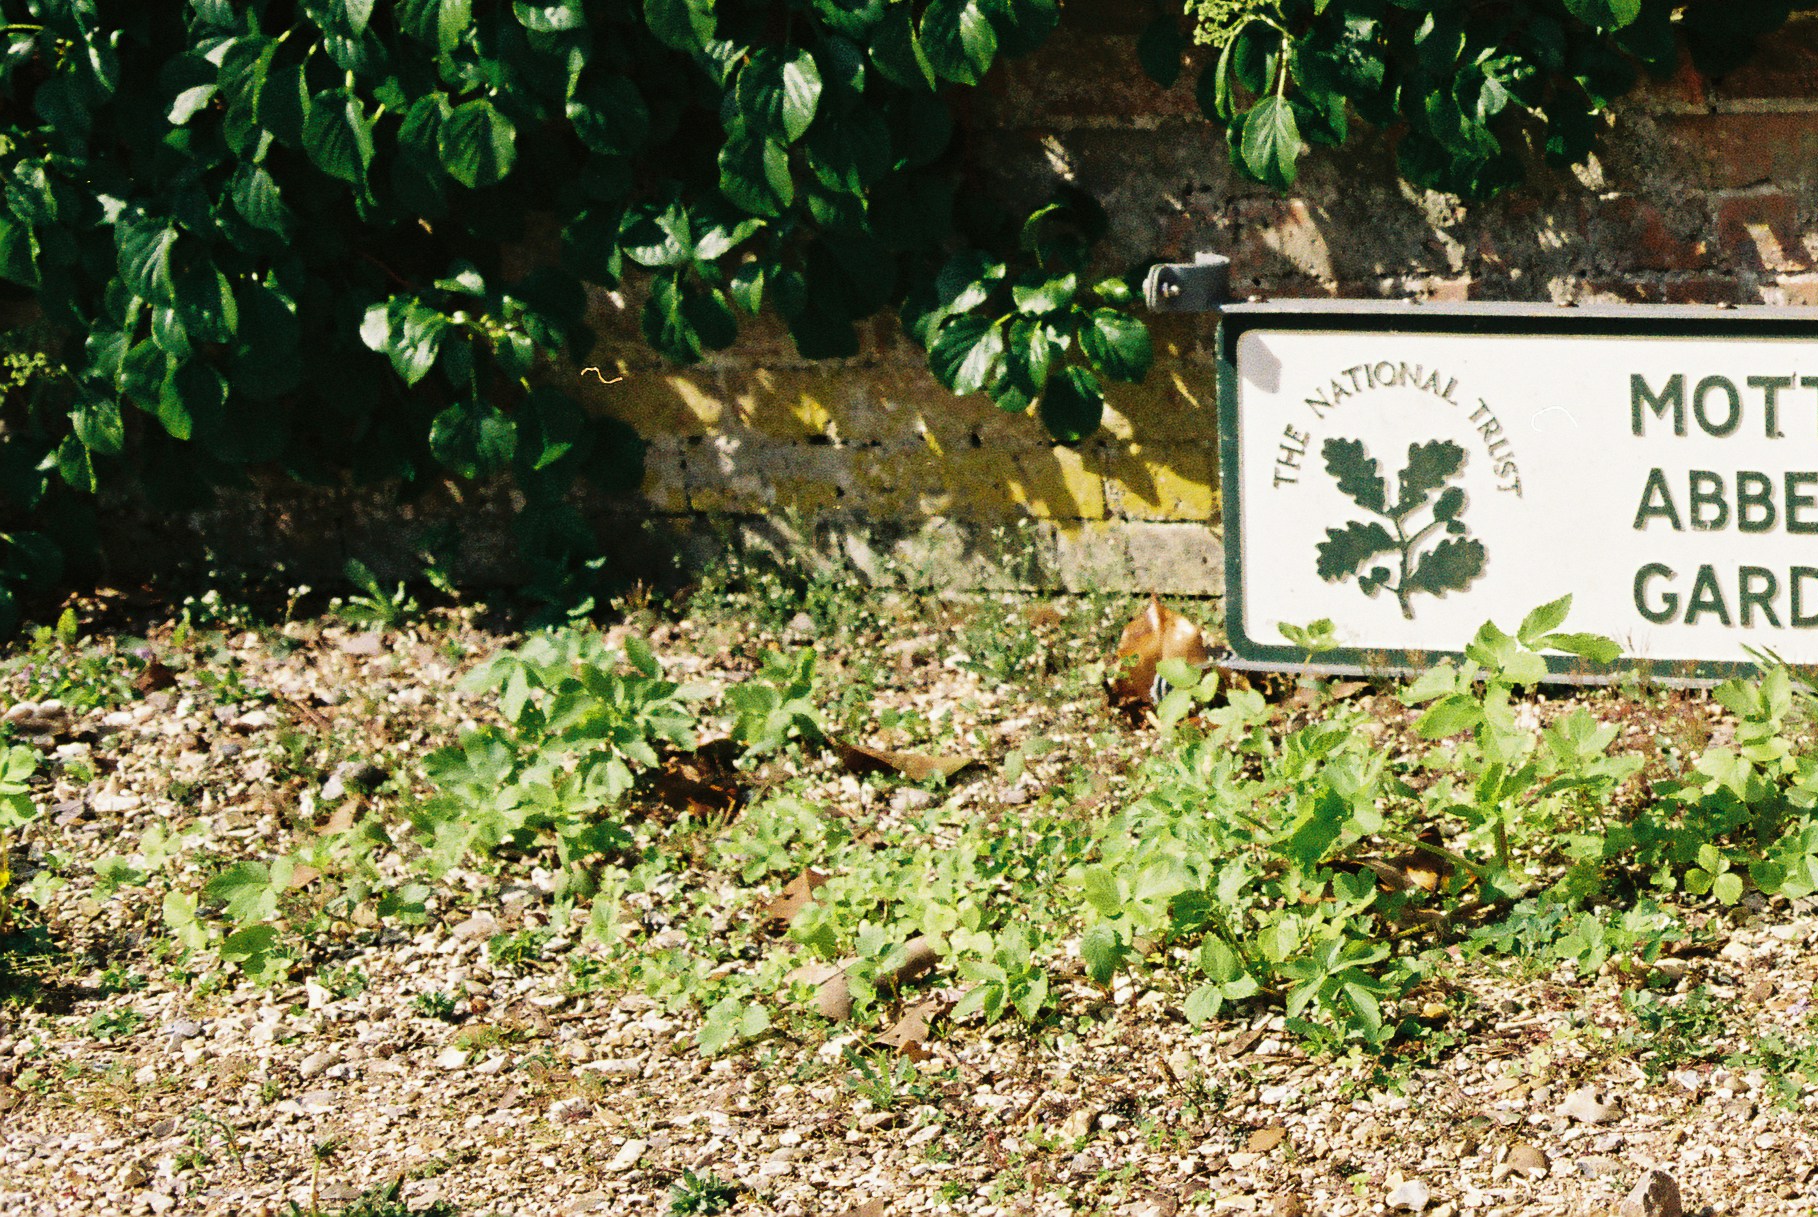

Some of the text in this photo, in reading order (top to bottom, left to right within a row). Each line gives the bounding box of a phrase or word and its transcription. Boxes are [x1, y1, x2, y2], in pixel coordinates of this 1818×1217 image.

[1273, 361, 1523, 498] THE NATIONAL TRUST
